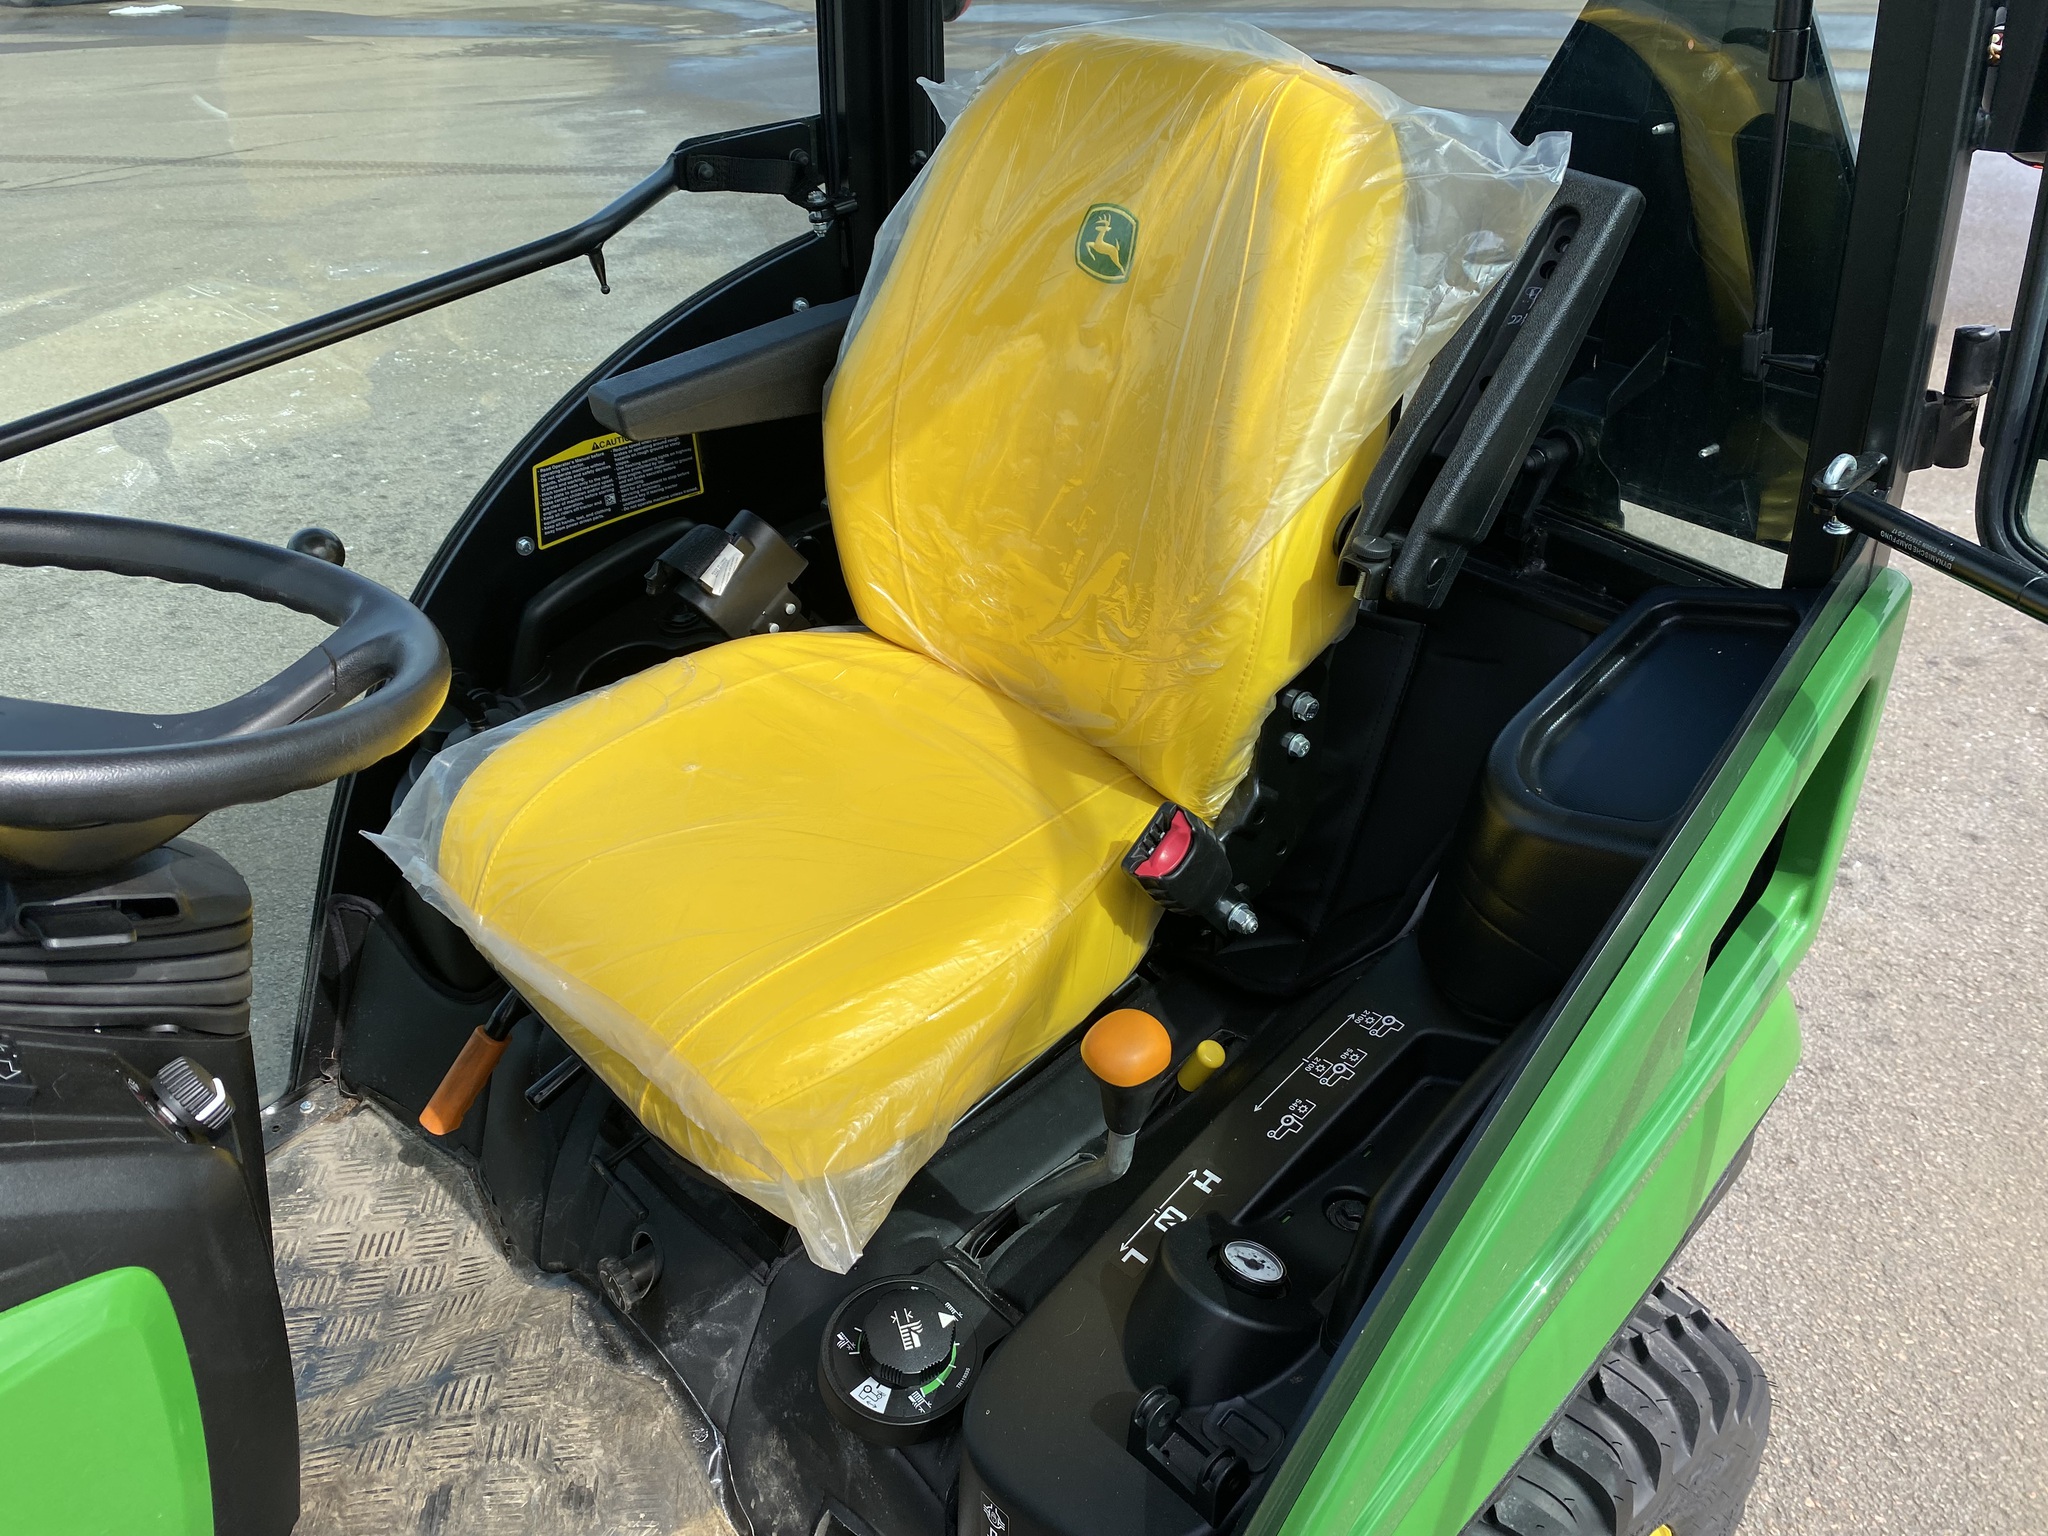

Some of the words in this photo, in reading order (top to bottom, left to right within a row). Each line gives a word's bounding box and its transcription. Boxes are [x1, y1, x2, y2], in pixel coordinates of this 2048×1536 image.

[600, 436, 630, 448] CAUTI
[1354, 1010, 1370, 1024] 2100
[1340, 1048, 1354, 1060] 540
[1304, 1056, 1321, 1072] 2100
[1288, 1098, 1302, 1110] 540
[1192, 1168, 1222, 1194] H
[1121, 1248, 1148, 1264] L
